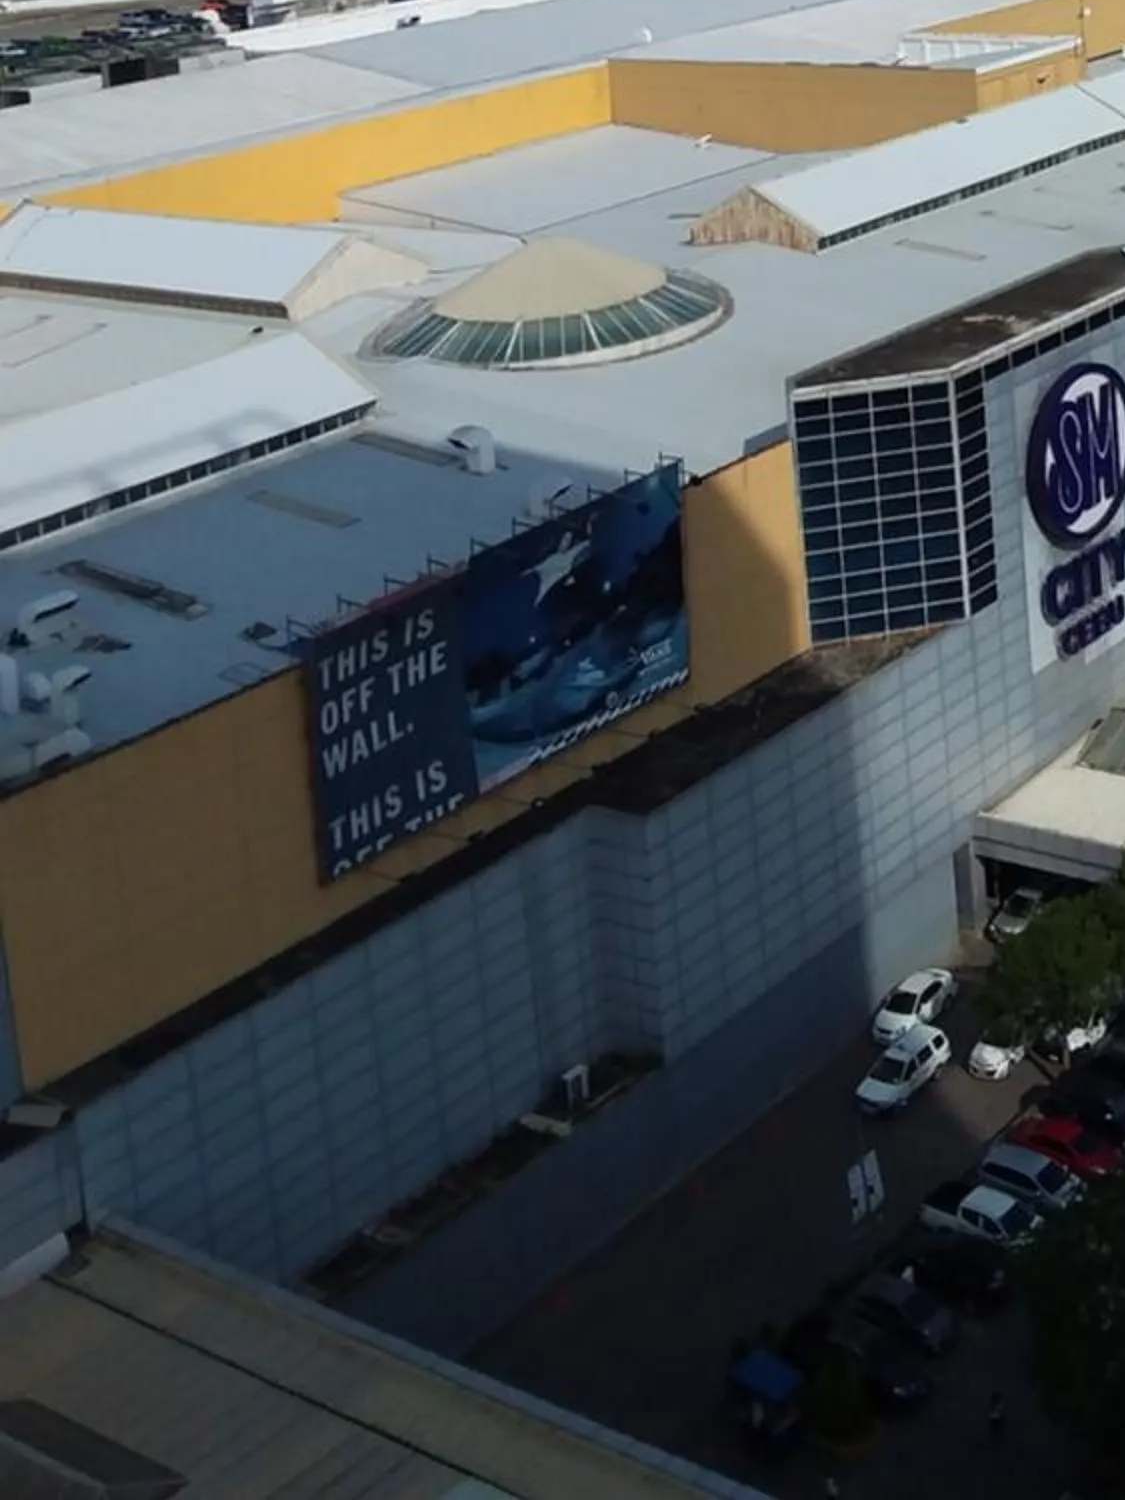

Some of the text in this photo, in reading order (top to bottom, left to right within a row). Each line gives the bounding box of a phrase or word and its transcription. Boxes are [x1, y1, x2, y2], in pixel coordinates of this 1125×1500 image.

[1047, 376, 1122, 528] SM
[319, 608, 435, 691] THIS IS
[320, 640, 448, 735] OFF THE
[322, 710, 414, 780] WALL.
[328, 784, 403, 851] THIS
[415, 759, 448, 801] IS
